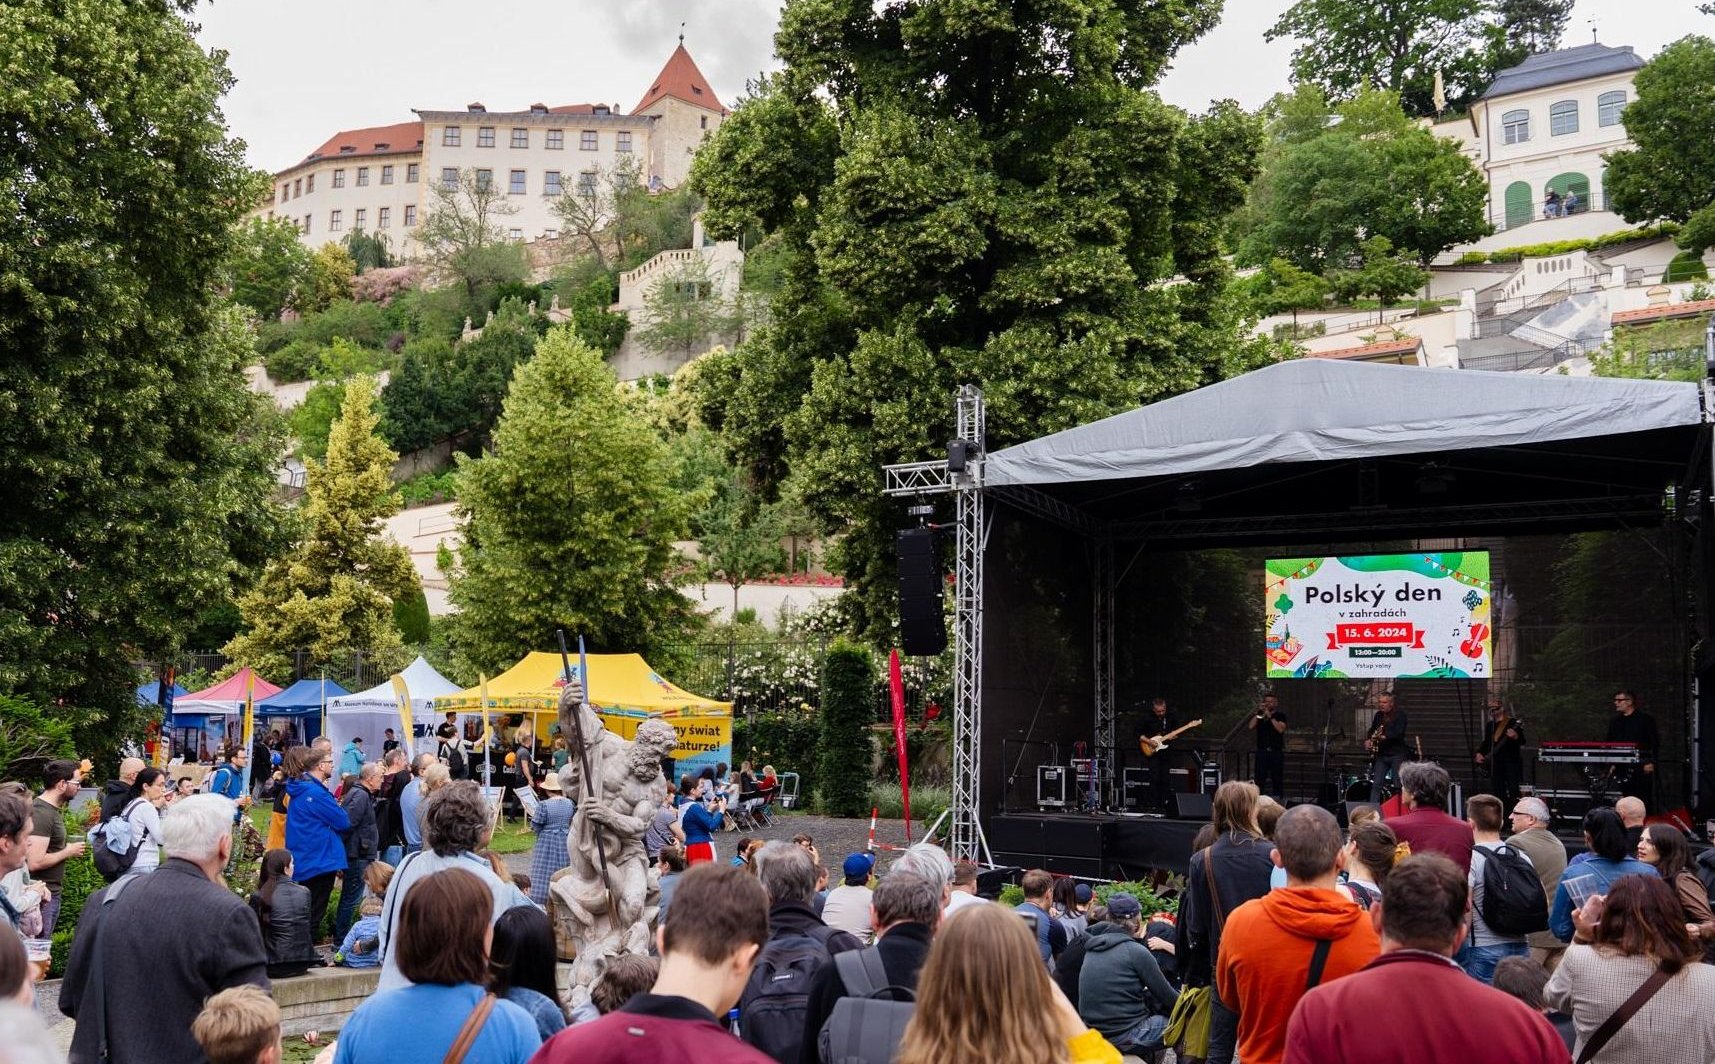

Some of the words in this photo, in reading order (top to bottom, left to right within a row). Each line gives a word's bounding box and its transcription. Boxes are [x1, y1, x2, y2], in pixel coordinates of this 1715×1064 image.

[1305, 582, 1386, 607] Polský
[1395, 582, 1442, 602] den
[1349, 607, 1407, 618] zahradách
[1344, 628, 1361, 638] 15.
[1363, 628, 1375, 638] 6.
[1378, 627, 1407, 637] 2024
[673, 726, 686, 737] ny
[688, 724, 721, 736] świat
[676, 739, 720, 752] iaturze!
